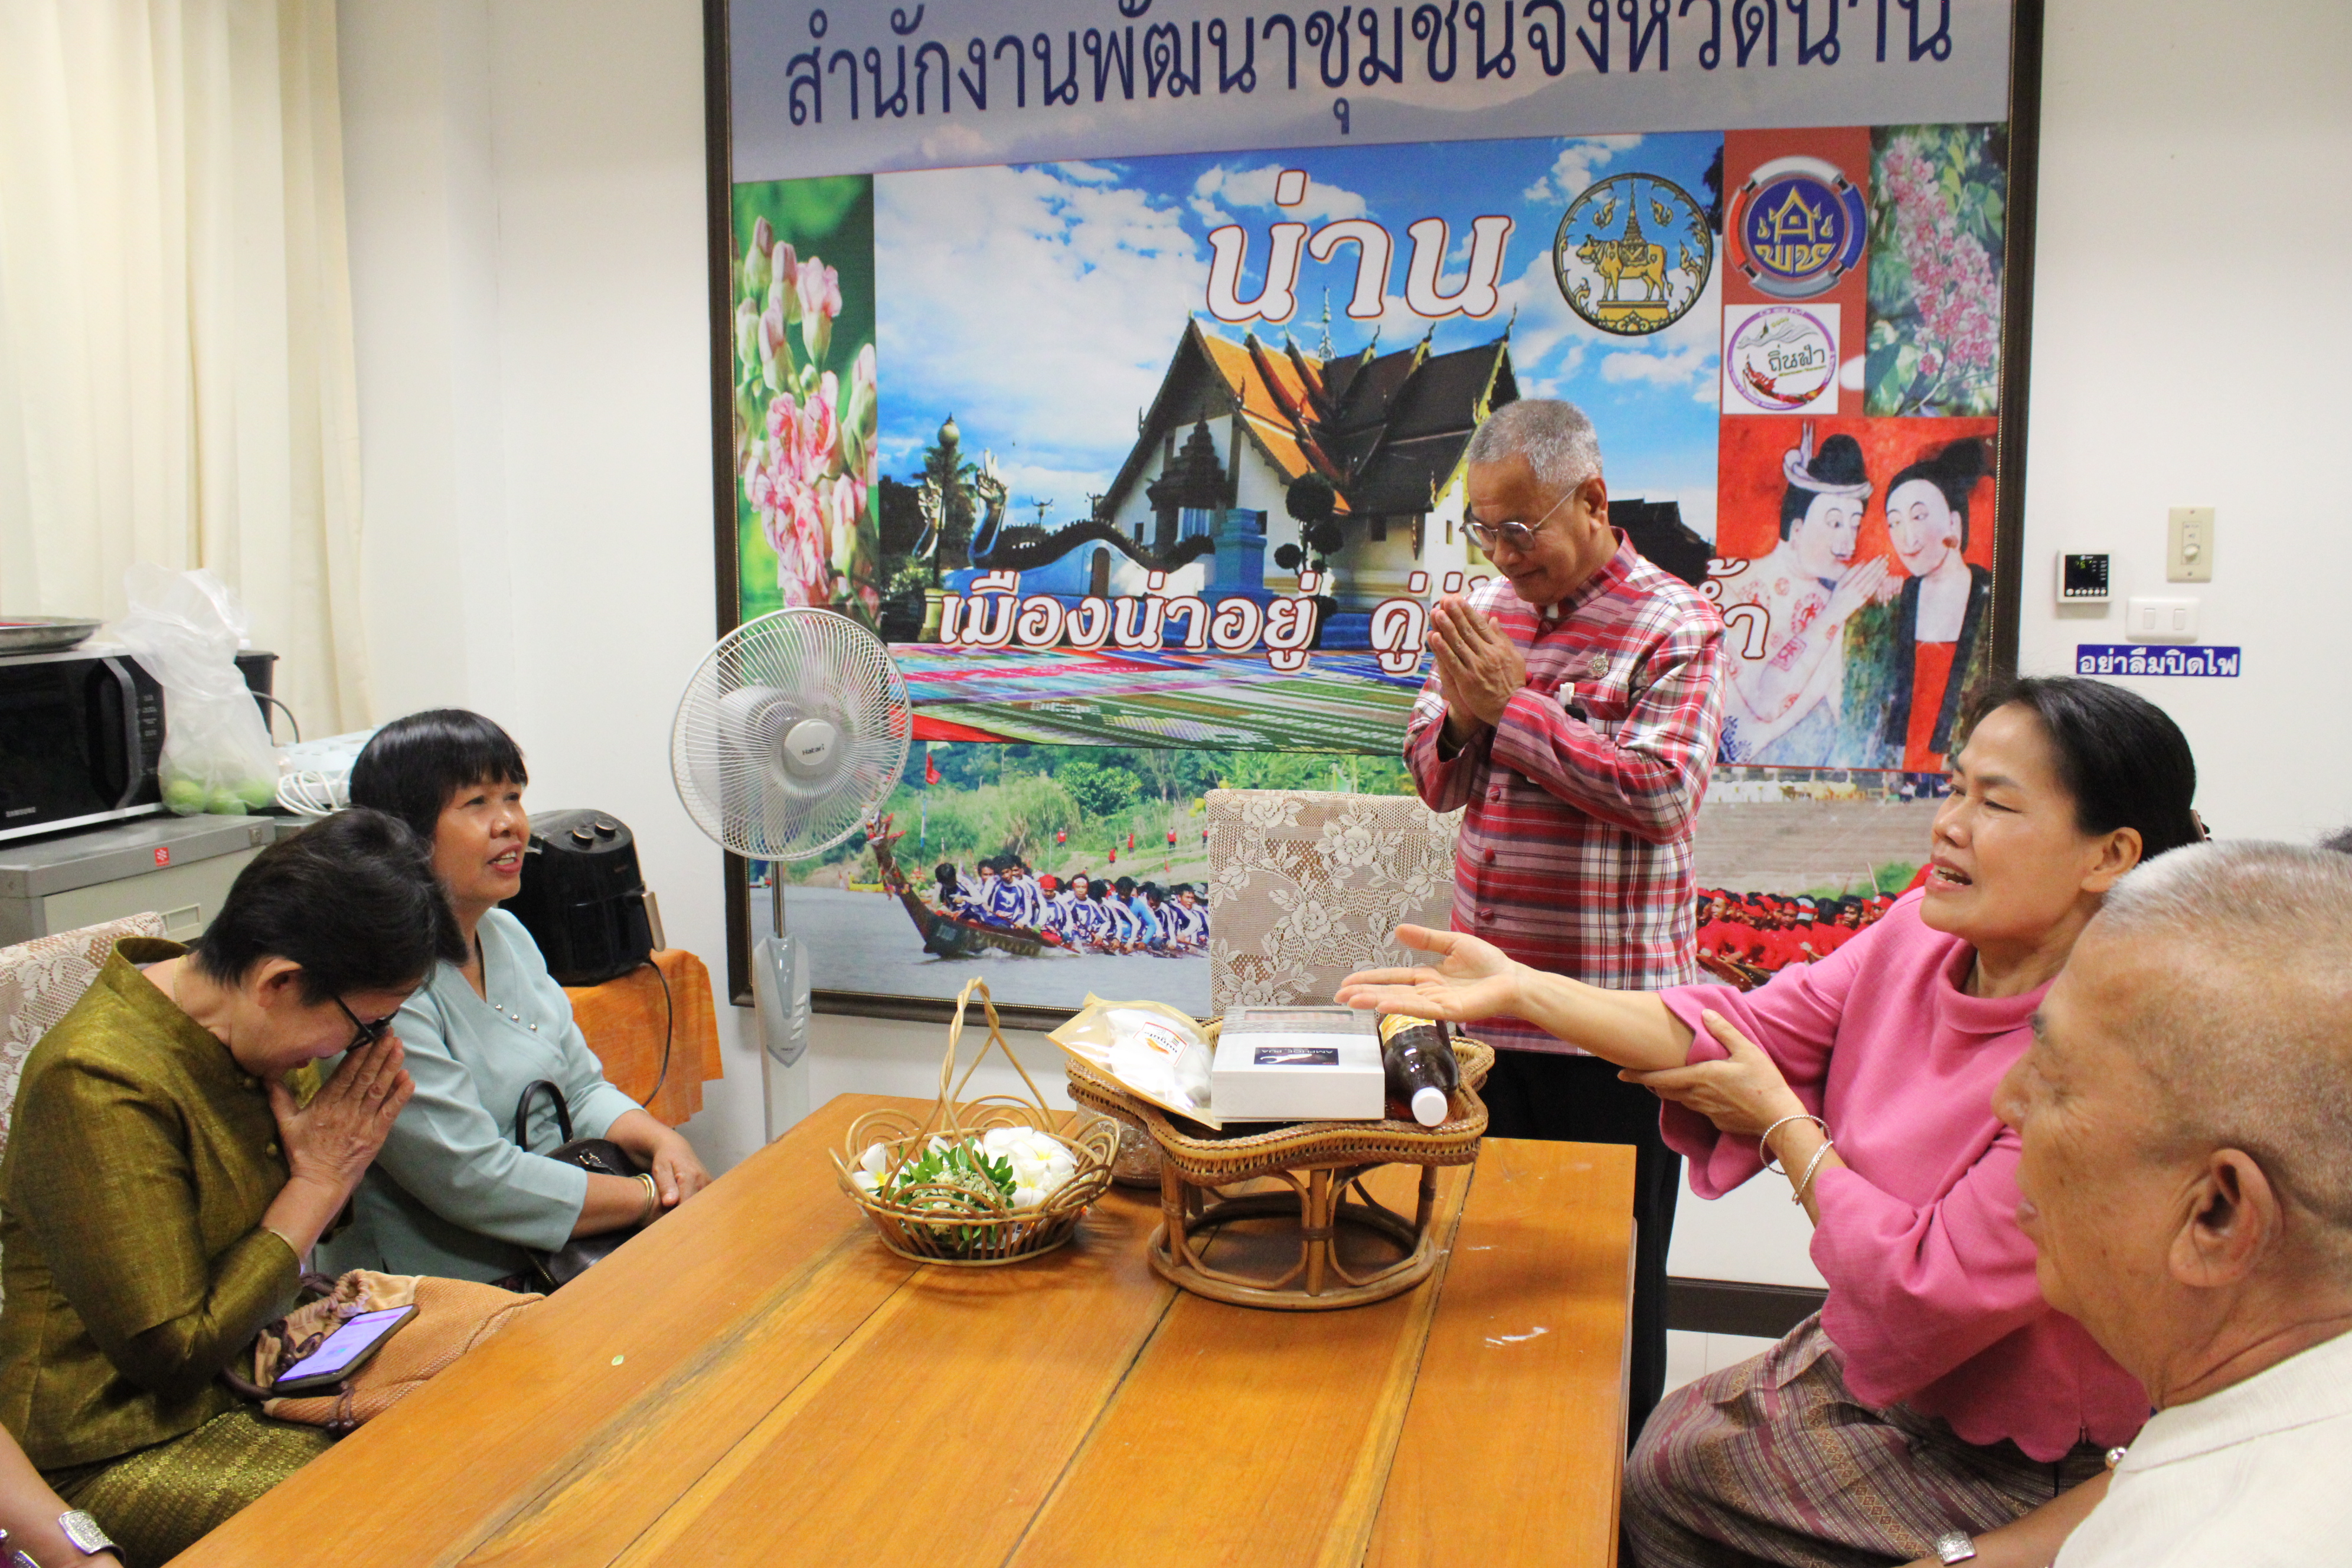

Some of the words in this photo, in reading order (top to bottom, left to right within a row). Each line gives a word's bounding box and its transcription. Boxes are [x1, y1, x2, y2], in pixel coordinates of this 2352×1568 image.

[785, 0, 1952, 135] สำนักงานพัฒนาชุมชนจงหวดนาน
[1206, 169, 1515, 323] น่าน
[939, 569, 1320, 673] เมืองน่าอยู่
[2079, 647, 2239, 675] อย่าลืมปิดไฟ
[802, 743, 825, 756] Hatari
